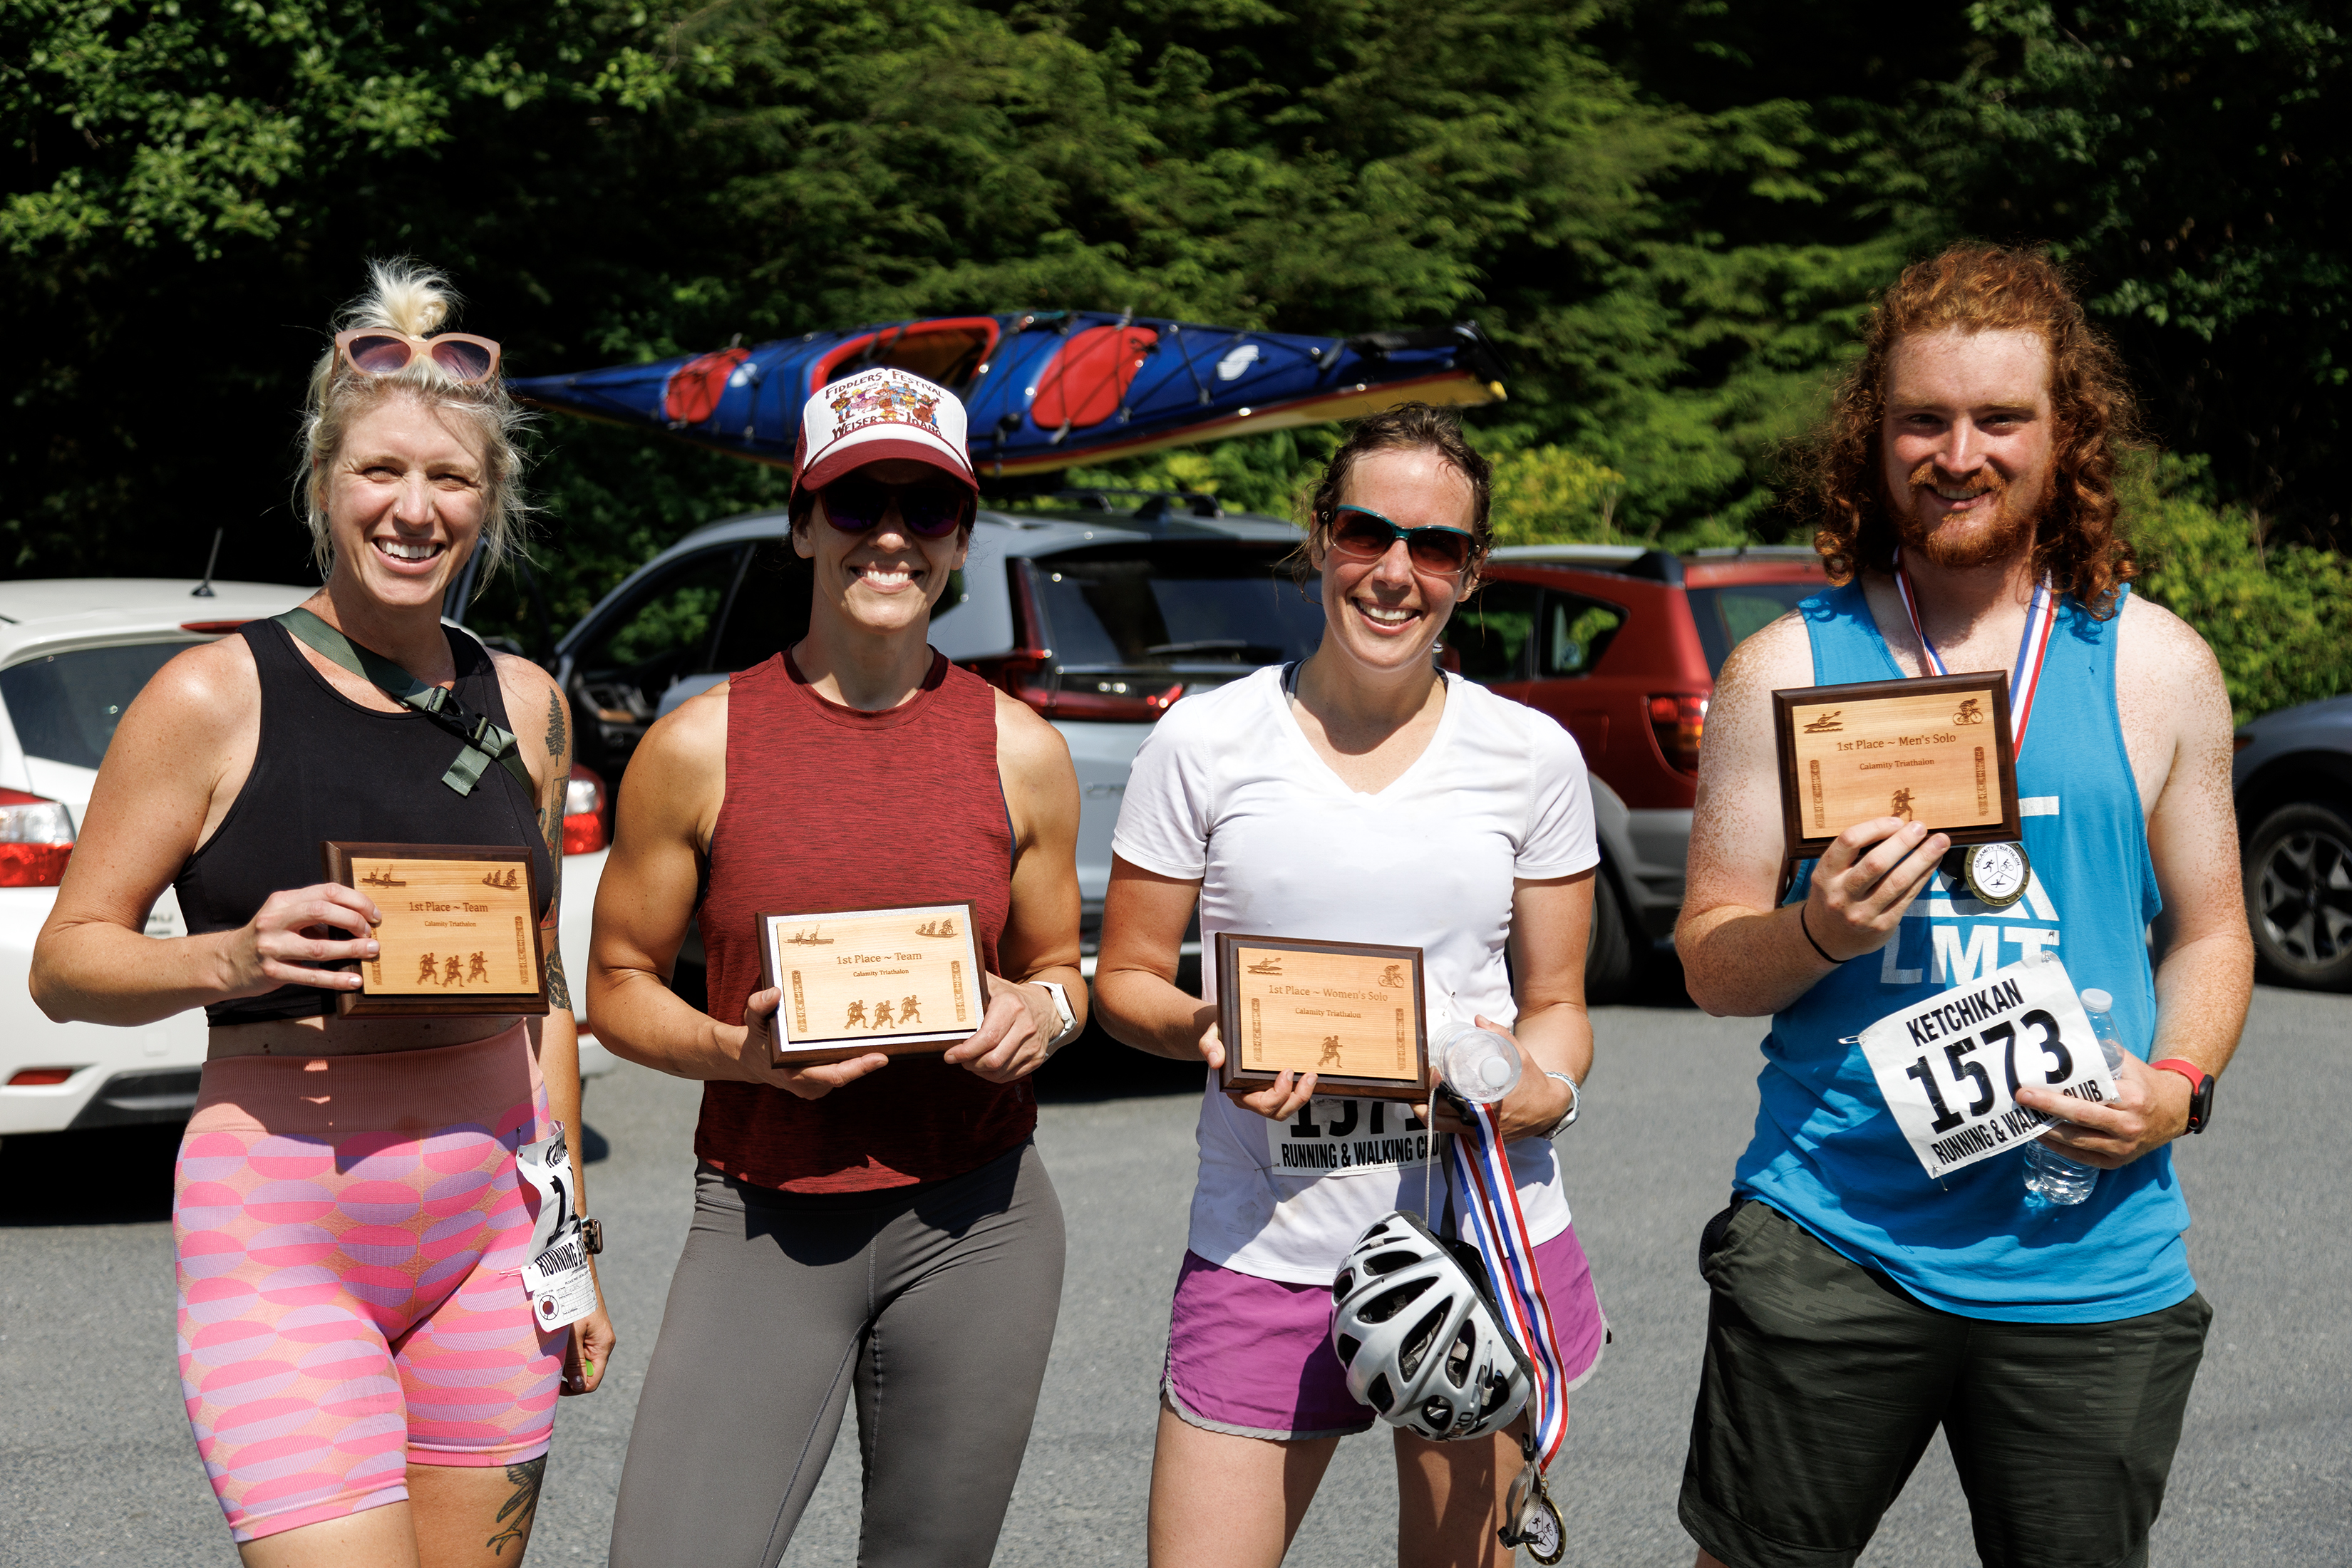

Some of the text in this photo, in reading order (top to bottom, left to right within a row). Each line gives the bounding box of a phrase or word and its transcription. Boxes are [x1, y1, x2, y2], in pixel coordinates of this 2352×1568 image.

[825, 371, 944, 400] FIDDLERS FESTIVAL
[832, 416, 877, 440] WEISER
[1837, 741, 1854, 752] 1st
[1856, 739, 1885, 751] Place
[1899, 735, 1931, 747] Men's
[1933, 733, 1956, 743] Solo
[1860, 758, 1935, 770] Calamity Triathalon
[1975, 845, 2021, 868] CALAMITY TRIATHLON
[409, 902, 423, 912] 1st
[425, 902, 450, 912] Place
[463, 902, 489, 912] Team
[836, 955, 852, 965] 1st
[855, 954, 881, 964] Place
[894, 952, 922, 961] Team
[1880, 924, 2060, 984] LMT
[1269, 984, 1284, 994] 1st
[1285, 986, 1310, 996] Place
[1323, 988, 1366, 1000] Women's
[1368, 991, 1388, 1002] Solo
[1295, 1007, 1361, 1019] Calamity Triathalon
[1905, 977, 2026, 1048] KETCHIKAN
[1905, 1008, 2074, 1135] 1573
[1281, 1143, 1338, 1169] RUNNING
[1341, 1143, 1351, 1167] &
[1353, 1138, 1413, 1167] WALKING
[1930, 1123, 1996, 1166] RUNNING
[1990, 1119, 2009, 1143] &
[535, 1242, 578, 1278] RUNNING
